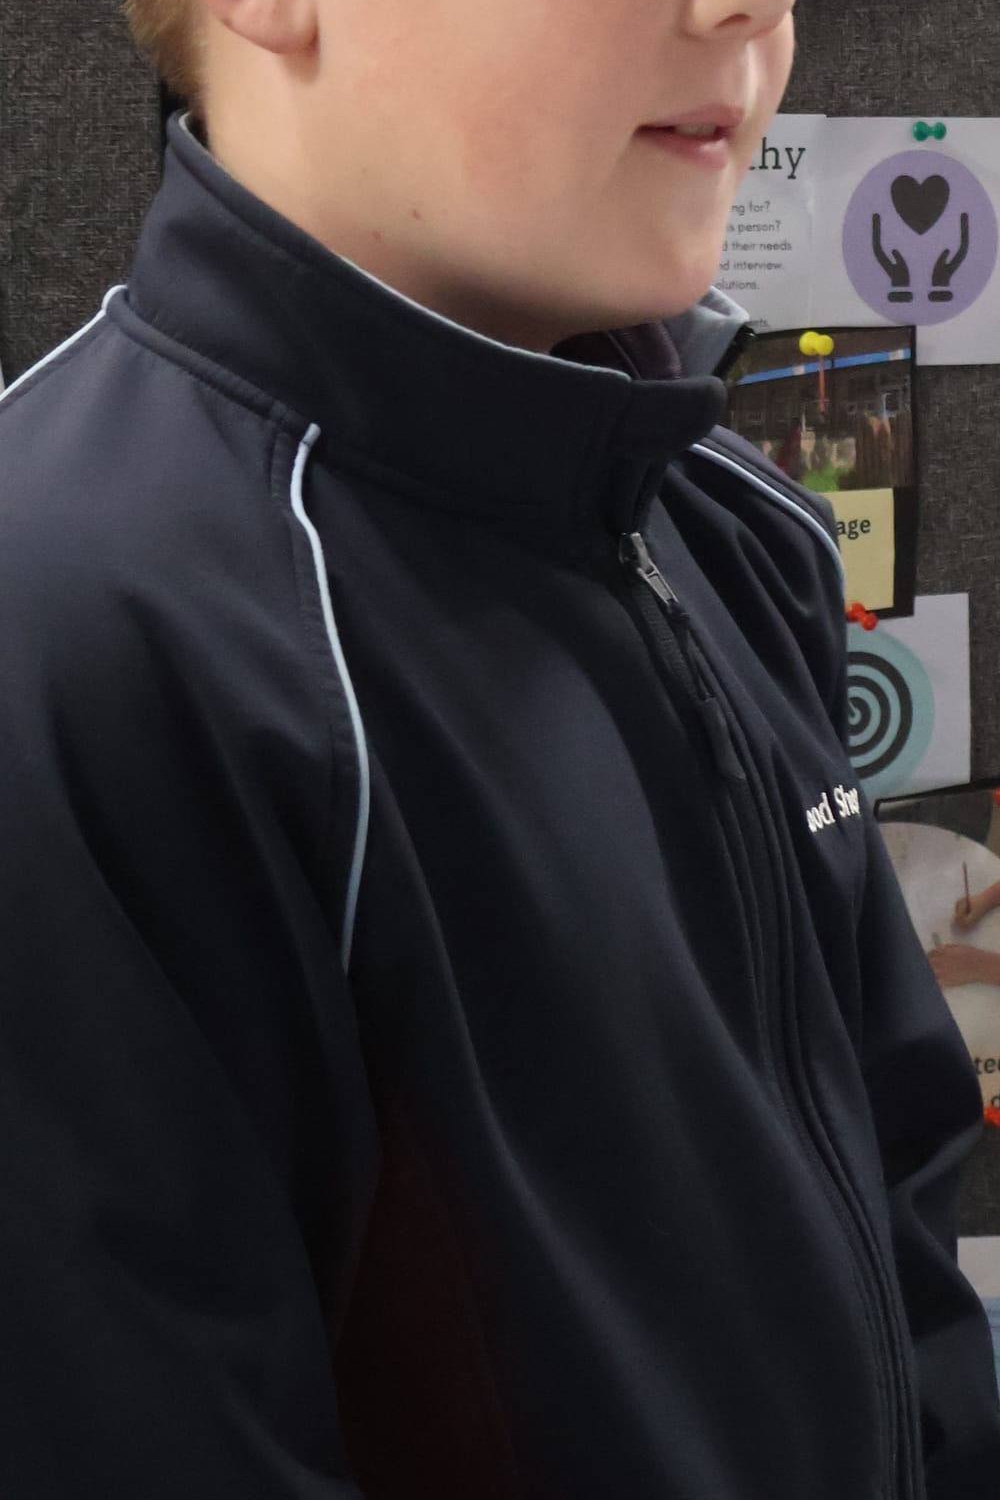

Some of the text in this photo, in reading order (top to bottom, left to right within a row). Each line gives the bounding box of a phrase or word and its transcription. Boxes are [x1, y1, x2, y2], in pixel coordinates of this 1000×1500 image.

[748, 137, 806, 179] hy
[715, 279, 760, 291] olutions.
[836, 519, 871, 540] age
